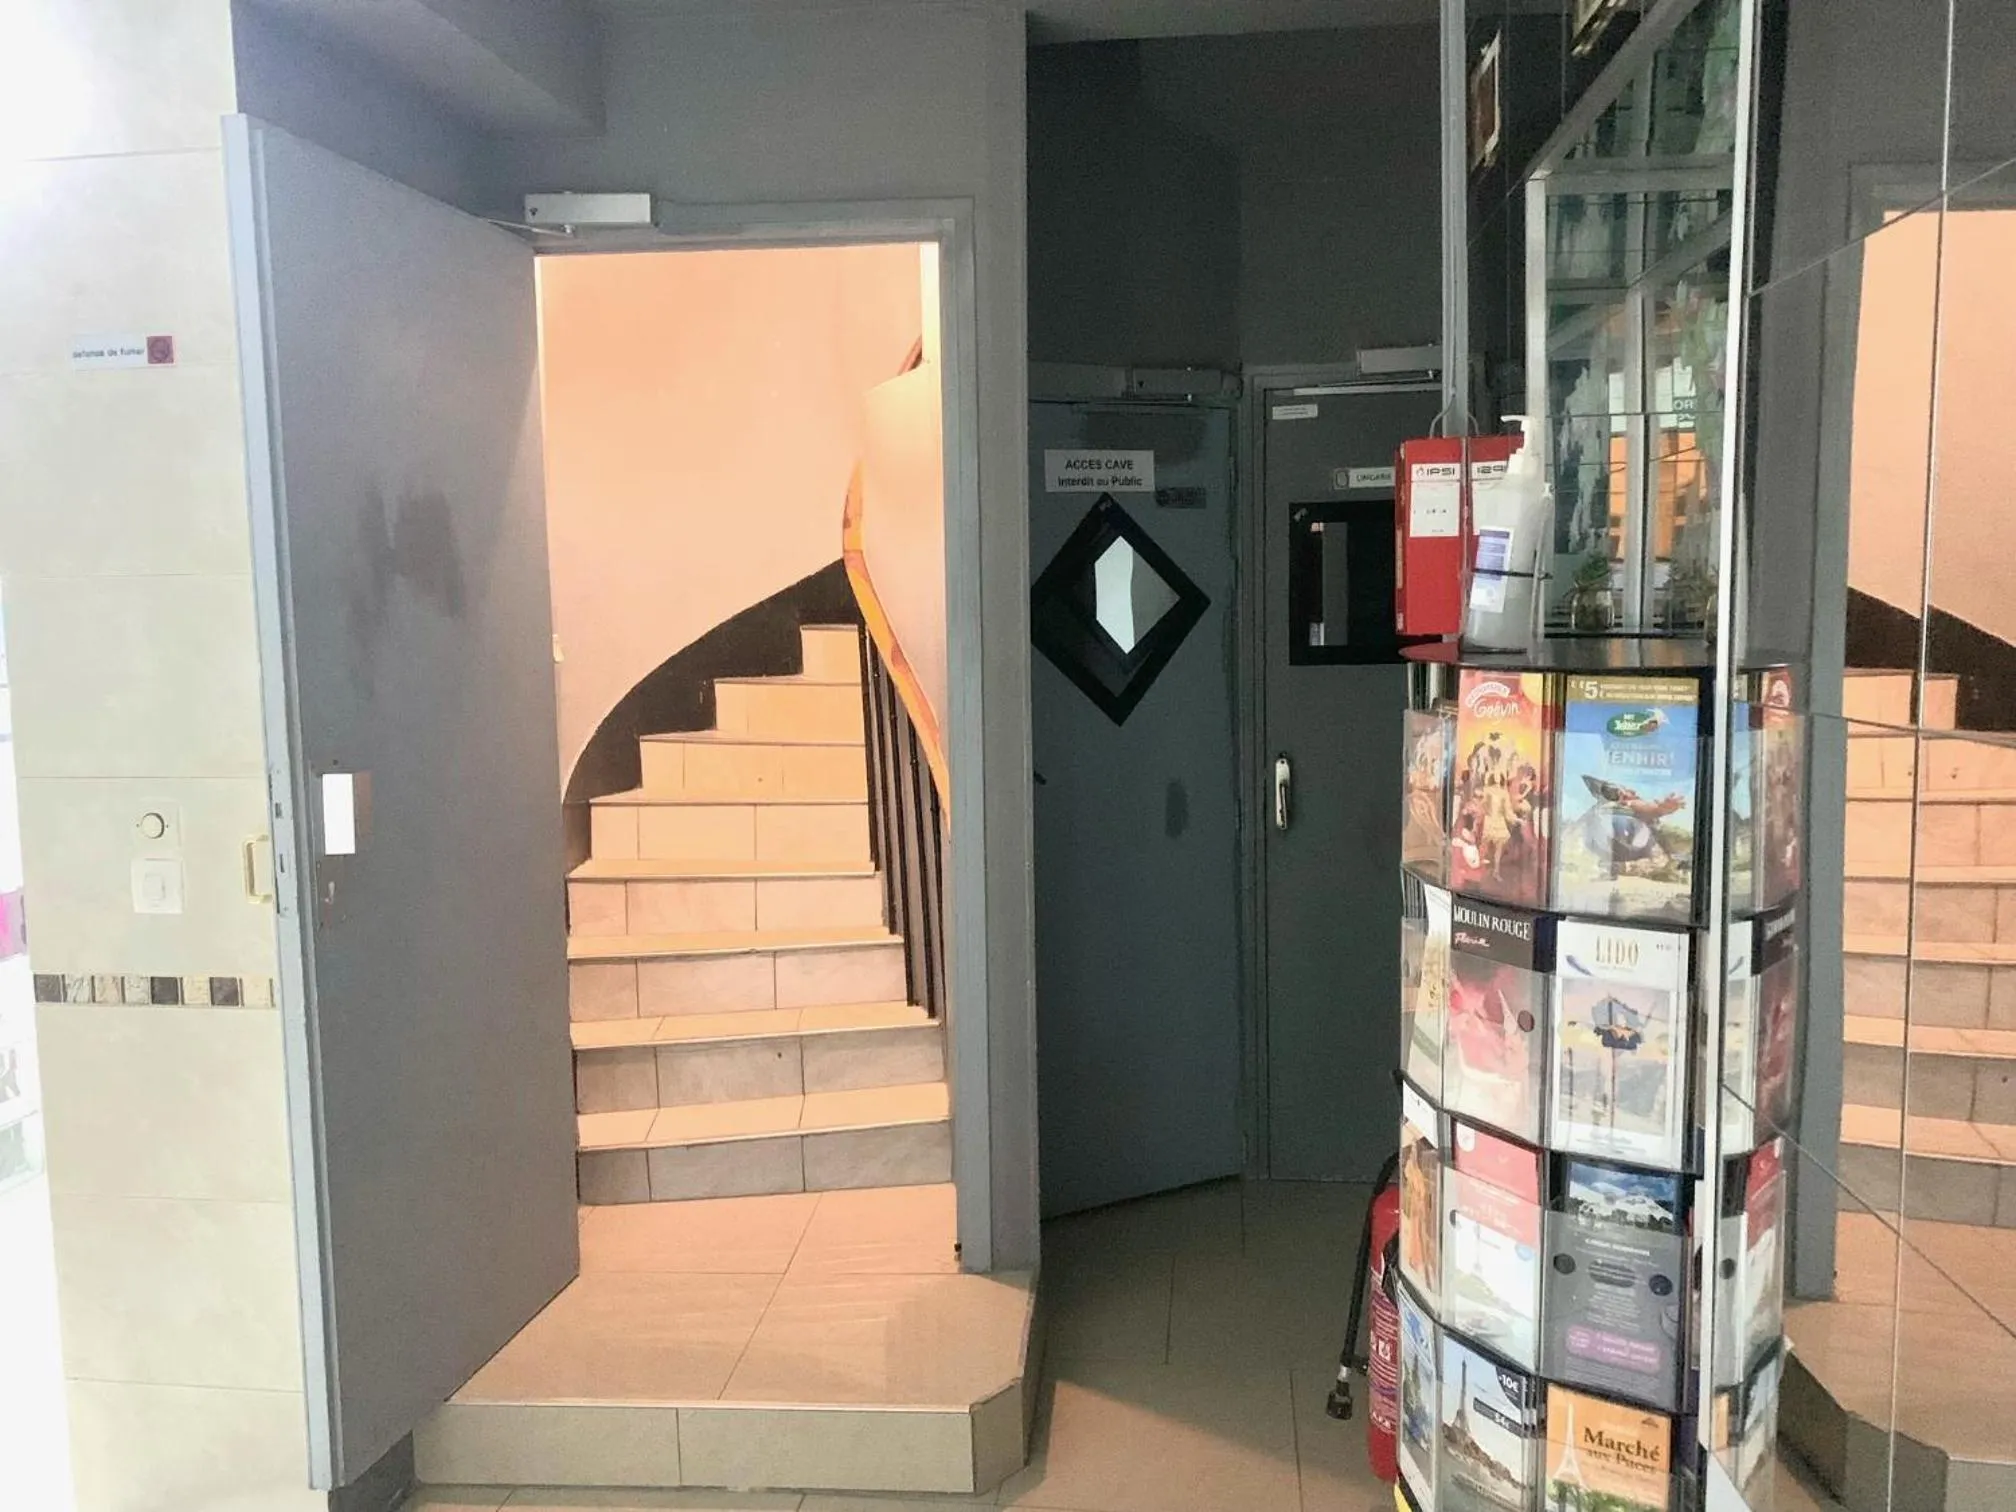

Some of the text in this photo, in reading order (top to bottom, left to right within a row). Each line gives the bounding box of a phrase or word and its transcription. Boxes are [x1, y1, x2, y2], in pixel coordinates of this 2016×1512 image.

[1065, 459, 1134, 470] ACCES CAVE
[1058, 476, 1094, 487] Interdit
[1111, 476, 1143, 487] Public
[1453, 904, 1531, 941] MOULIN ROUGE
[1596, 936, 1639, 965] LIDO
[1584, 1426, 1661, 1462] Marché
